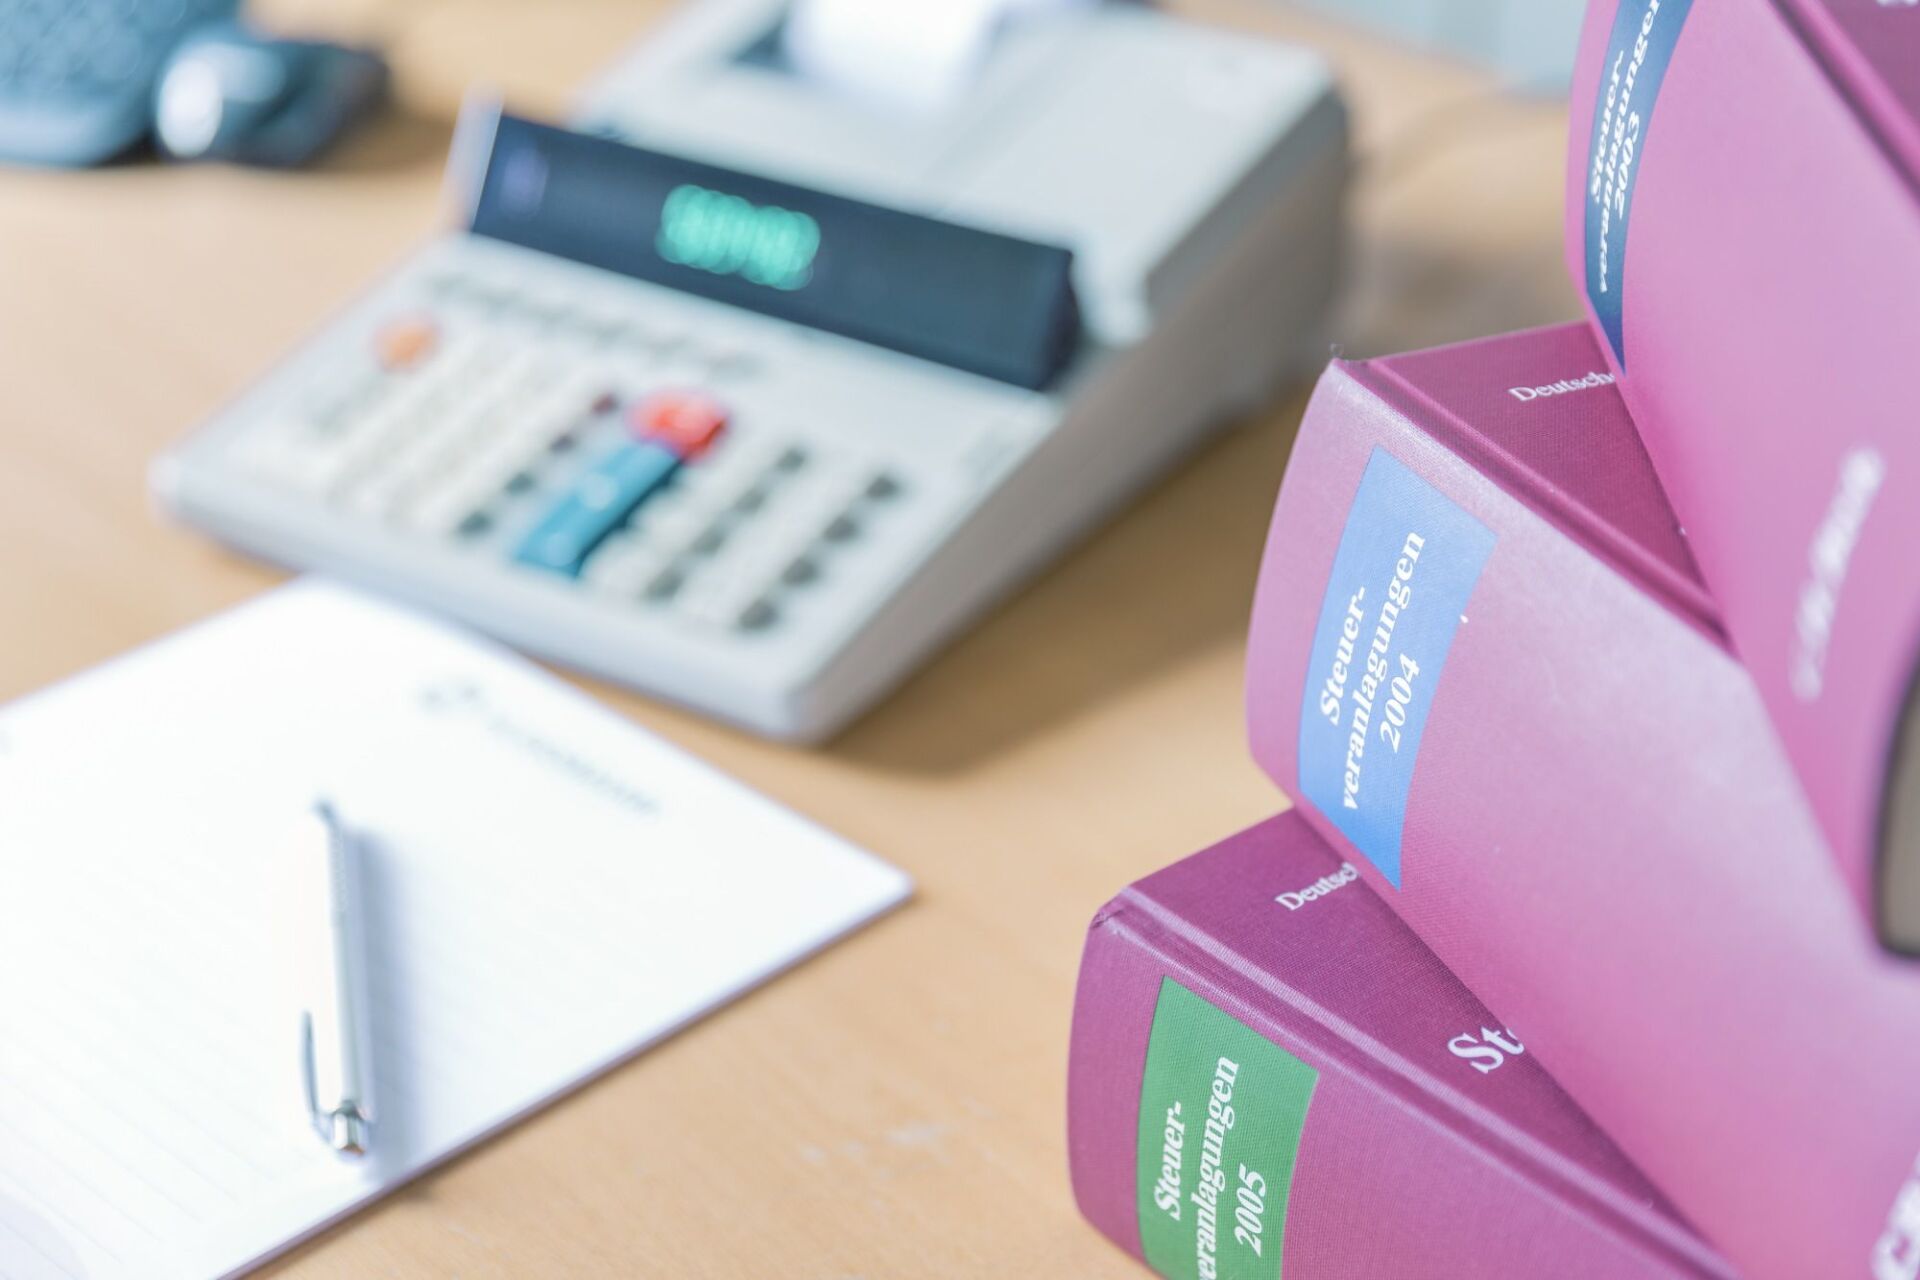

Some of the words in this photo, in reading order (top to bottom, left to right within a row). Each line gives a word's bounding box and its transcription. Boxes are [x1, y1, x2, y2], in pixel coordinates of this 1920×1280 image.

[1590, 50, 1624, 204] Steuer-
[1614, 111, 1640, 220] 2003
[1508, 371, 1615, 401] Deutsch
[1319, 586, 1367, 727] Steuer-
[1342, 531, 1426, 811] veranlagungen
[1379, 652, 1421, 754] 2004
[1447, 1026, 1525, 1074] St
[1153, 1100, 1187, 1222] Steuer-
[1190, 1055, 1240, 1280] eranlagungen
[1233, 1162, 1267, 1258] 2005
